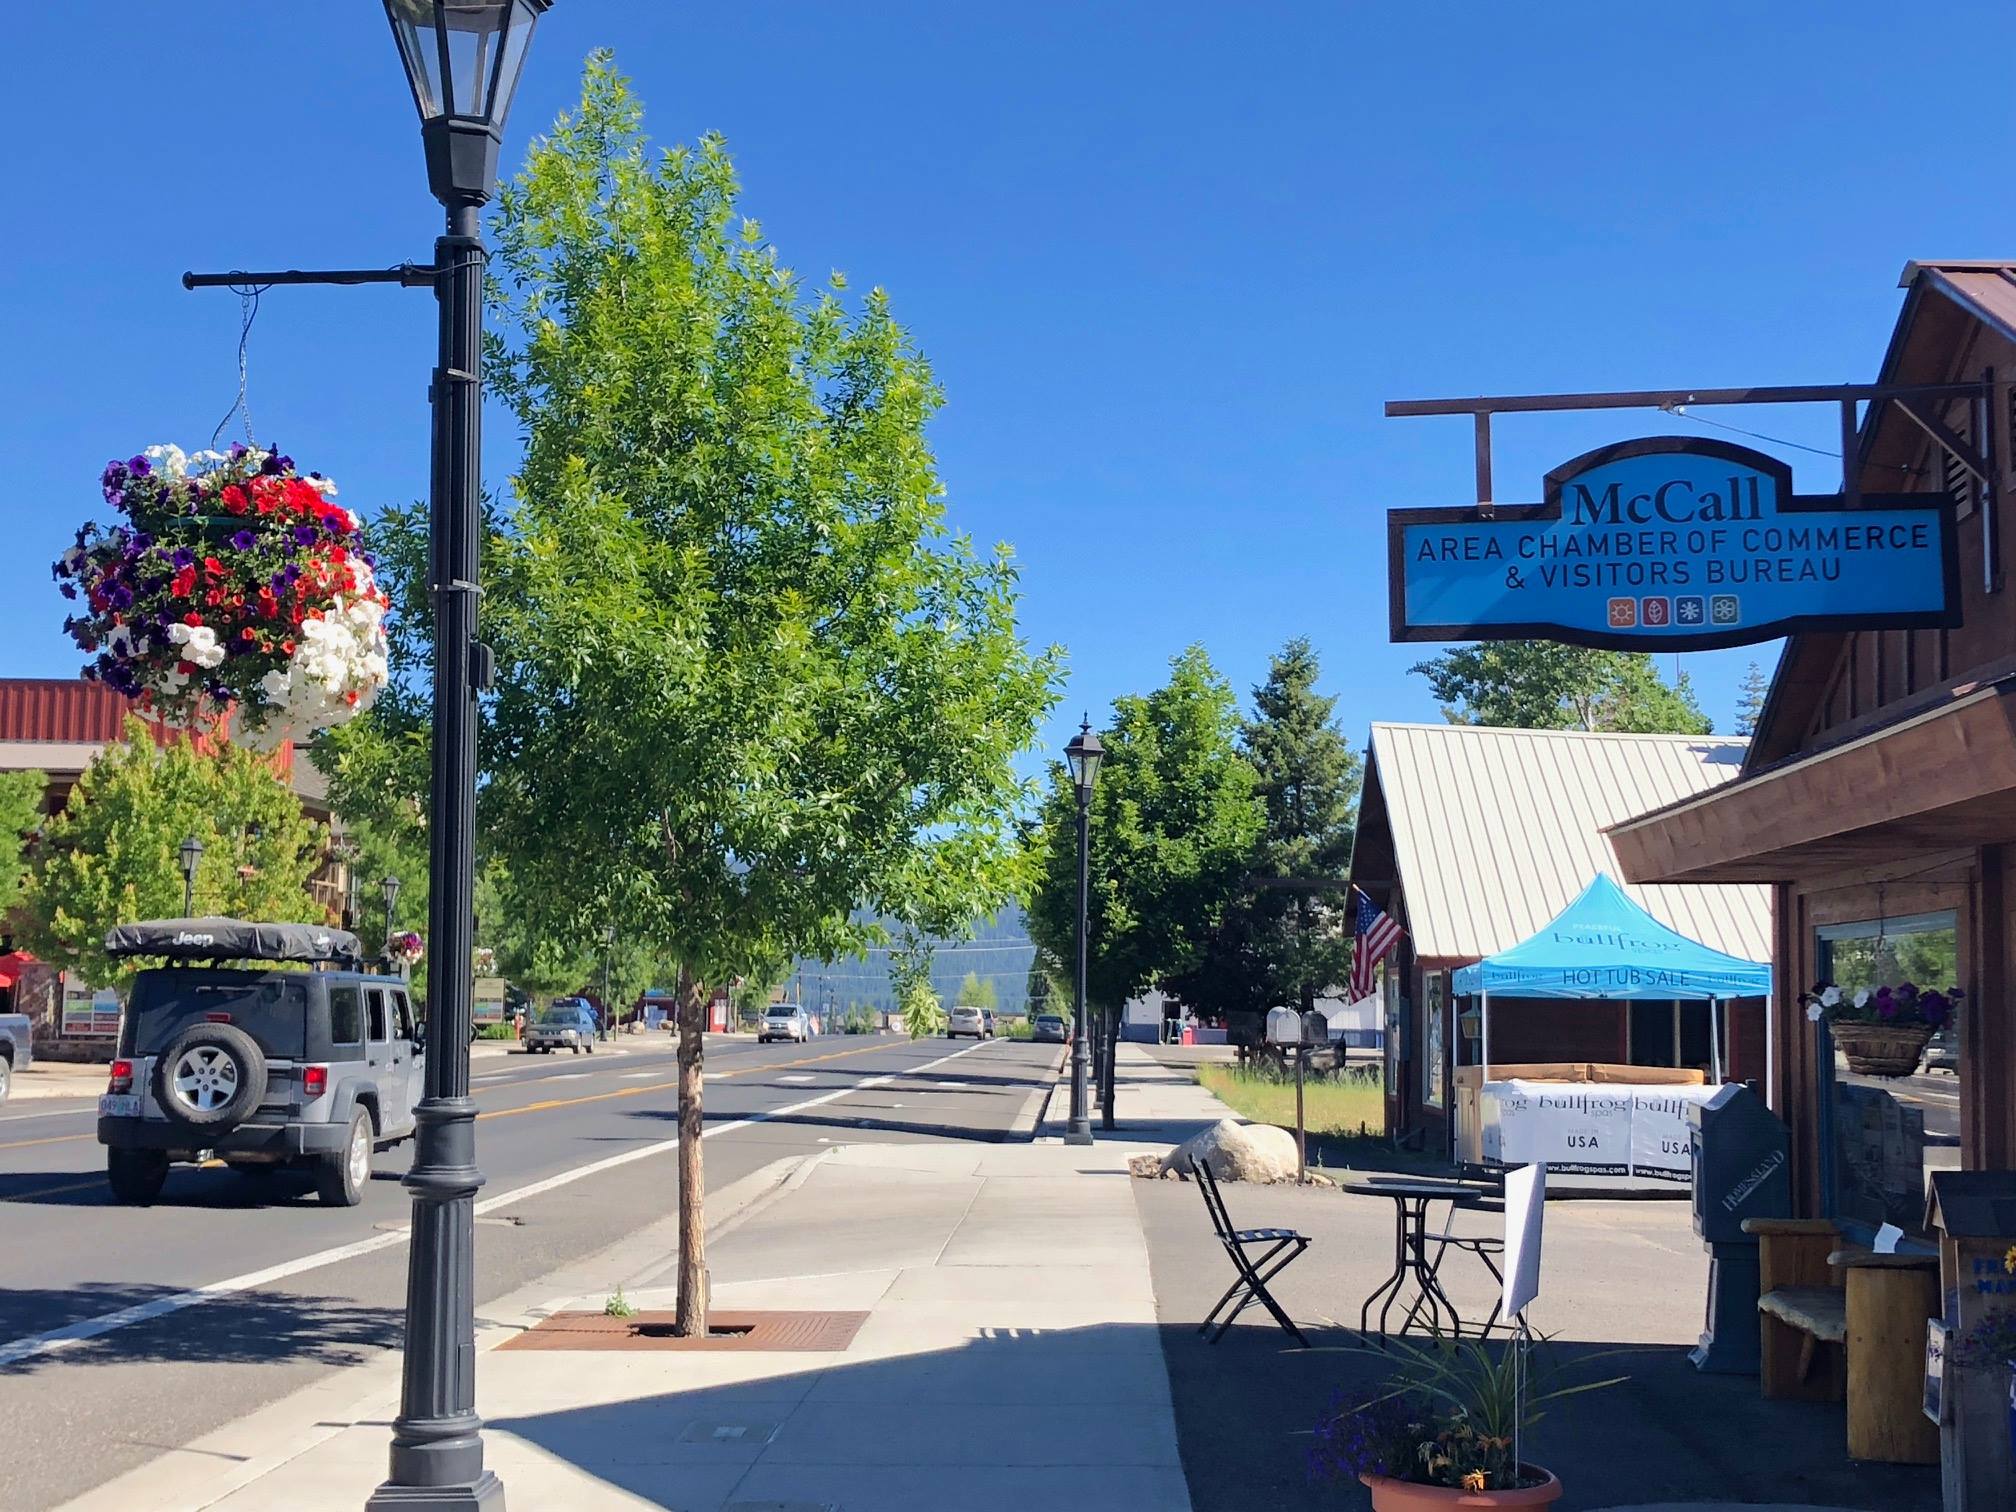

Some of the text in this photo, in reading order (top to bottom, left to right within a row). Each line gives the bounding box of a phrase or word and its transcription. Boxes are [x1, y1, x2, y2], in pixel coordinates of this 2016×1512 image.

[1570, 475, 1764, 526] McCall
[1416, 523, 1929, 562] AREA CHAMBER OF COMMERCE
[1504, 556, 1841, 590] & VISITORS BUREAU
[172, 931, 214, 947] Jeep
[1554, 932, 1681, 951] bullfrog
[1562, 969, 1690, 986] HOT TUB SALE
[1539, 1093, 1628, 1114] bullfrog
[1590, 1109, 1614, 1118] spas
[1567, 1135, 1599, 1149] USA
[1661, 1140, 1691, 1156] USA
[1547, 1163, 1626, 1174] ww.bullfrogspas.com
[1635, 1167, 1692, 1181] www.bullfrogsp
